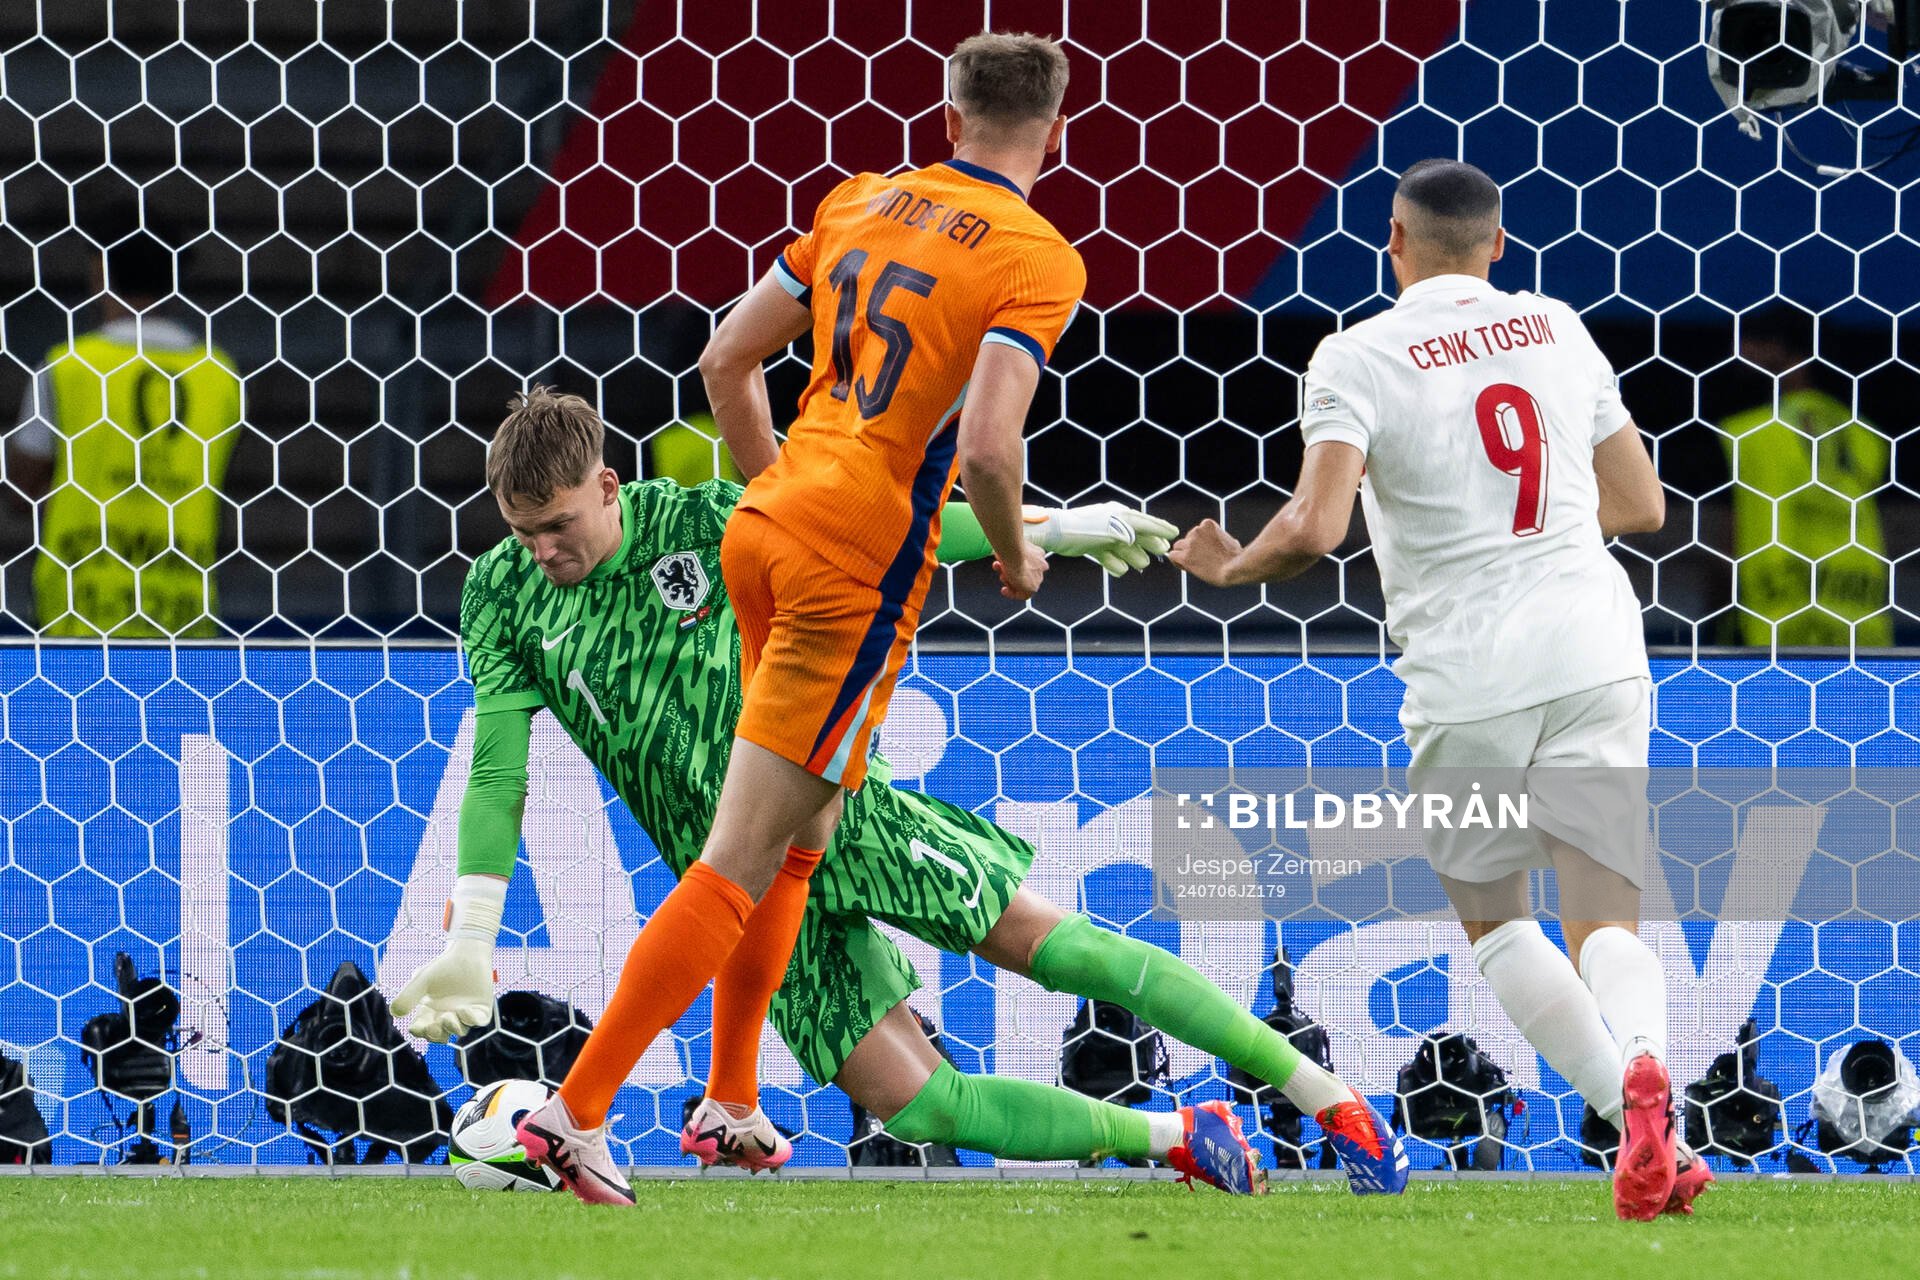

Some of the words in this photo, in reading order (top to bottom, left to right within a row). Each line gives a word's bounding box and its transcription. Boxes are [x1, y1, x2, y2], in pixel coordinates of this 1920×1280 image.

[937, 208, 991, 250] VEN
[828, 248, 938, 420] 15
[1408, 330, 1479, 370] CENK
[1474, 314, 1556, 356] TOSUN
[1475, 383, 1547, 537] 9
[567, 669, 607, 724] 1
[909, 837, 968, 877] 1
[376, 688, 1828, 1168] Apay
